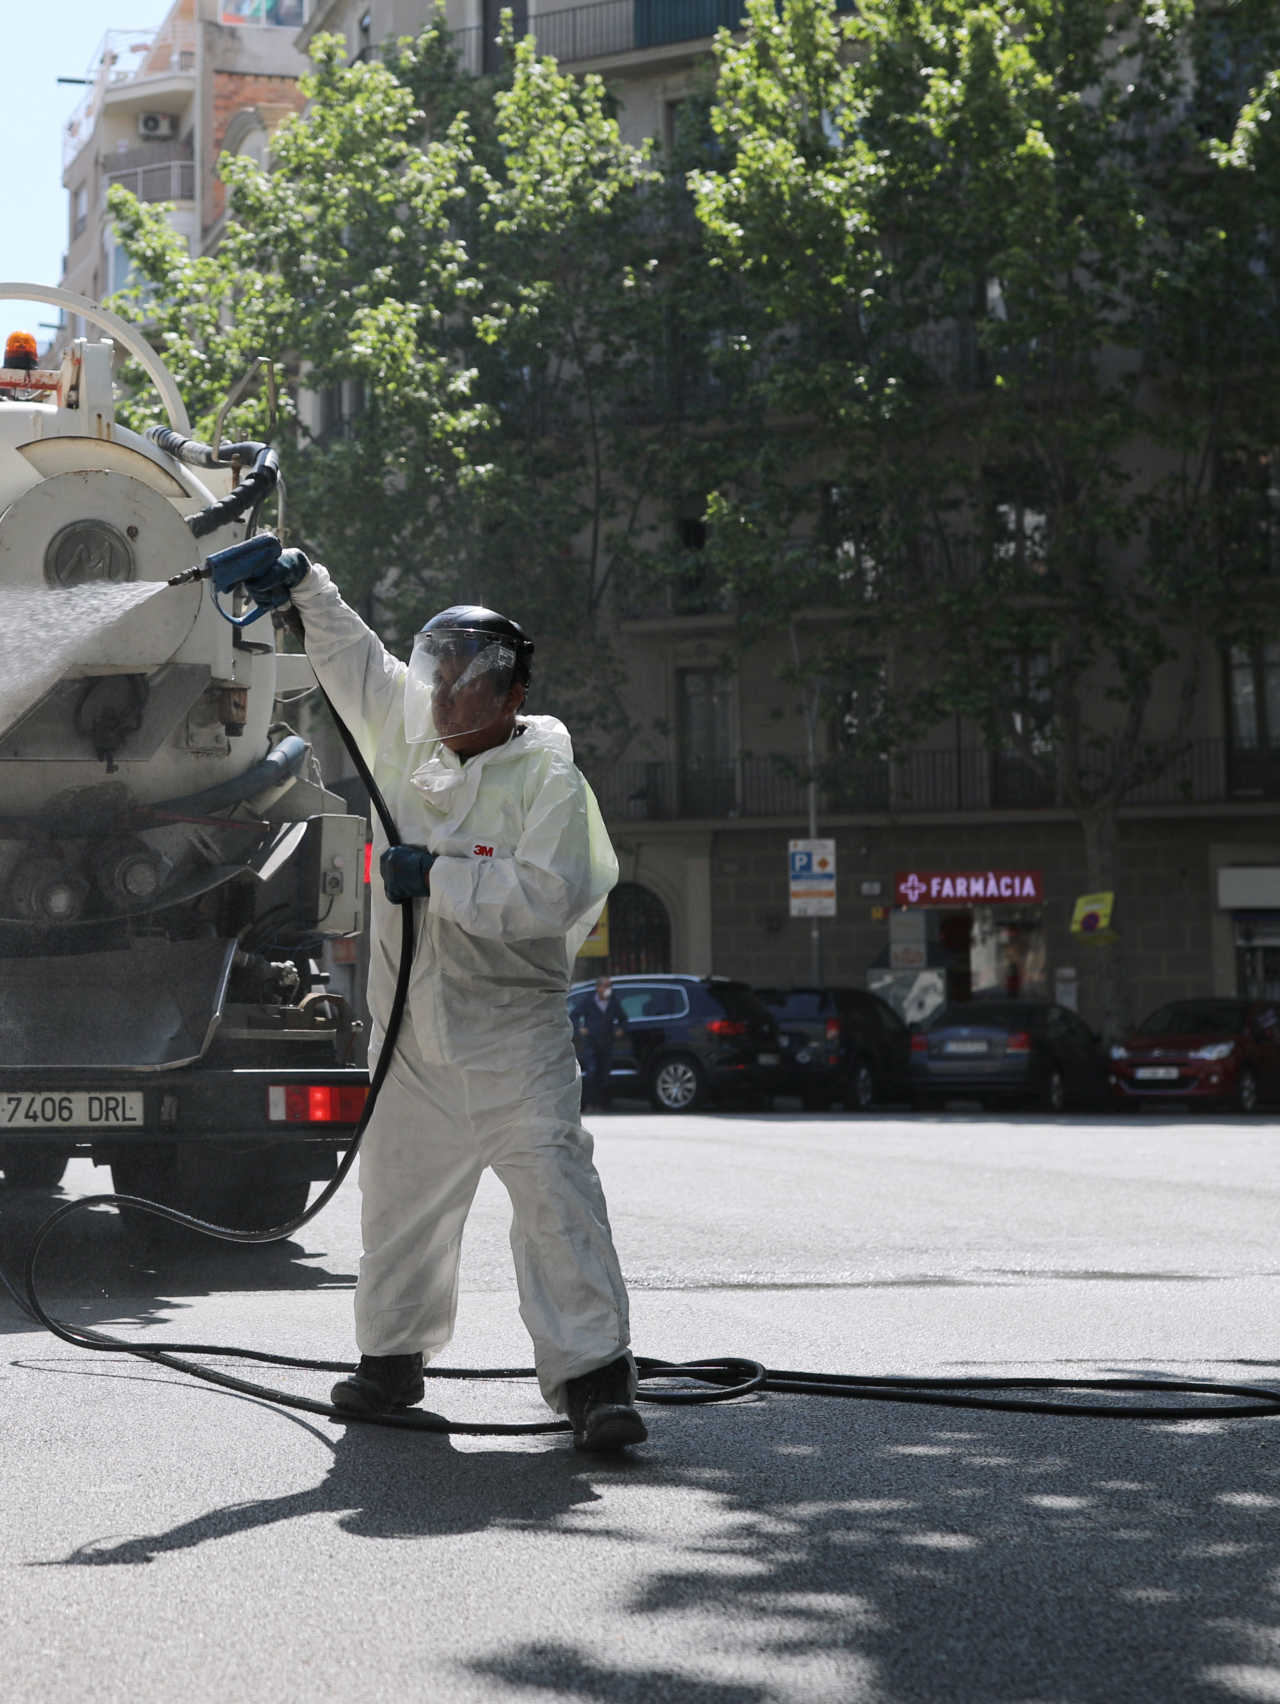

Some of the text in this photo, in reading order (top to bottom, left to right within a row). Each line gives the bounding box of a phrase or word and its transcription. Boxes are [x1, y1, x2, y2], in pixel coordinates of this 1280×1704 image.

[473, 844, 494, 857] 3M
[795, 854, 808, 873] P
[930, 871, 1036, 898] FARMÀCIA
[7, 1096, 137, 1122] 7406 DRL
